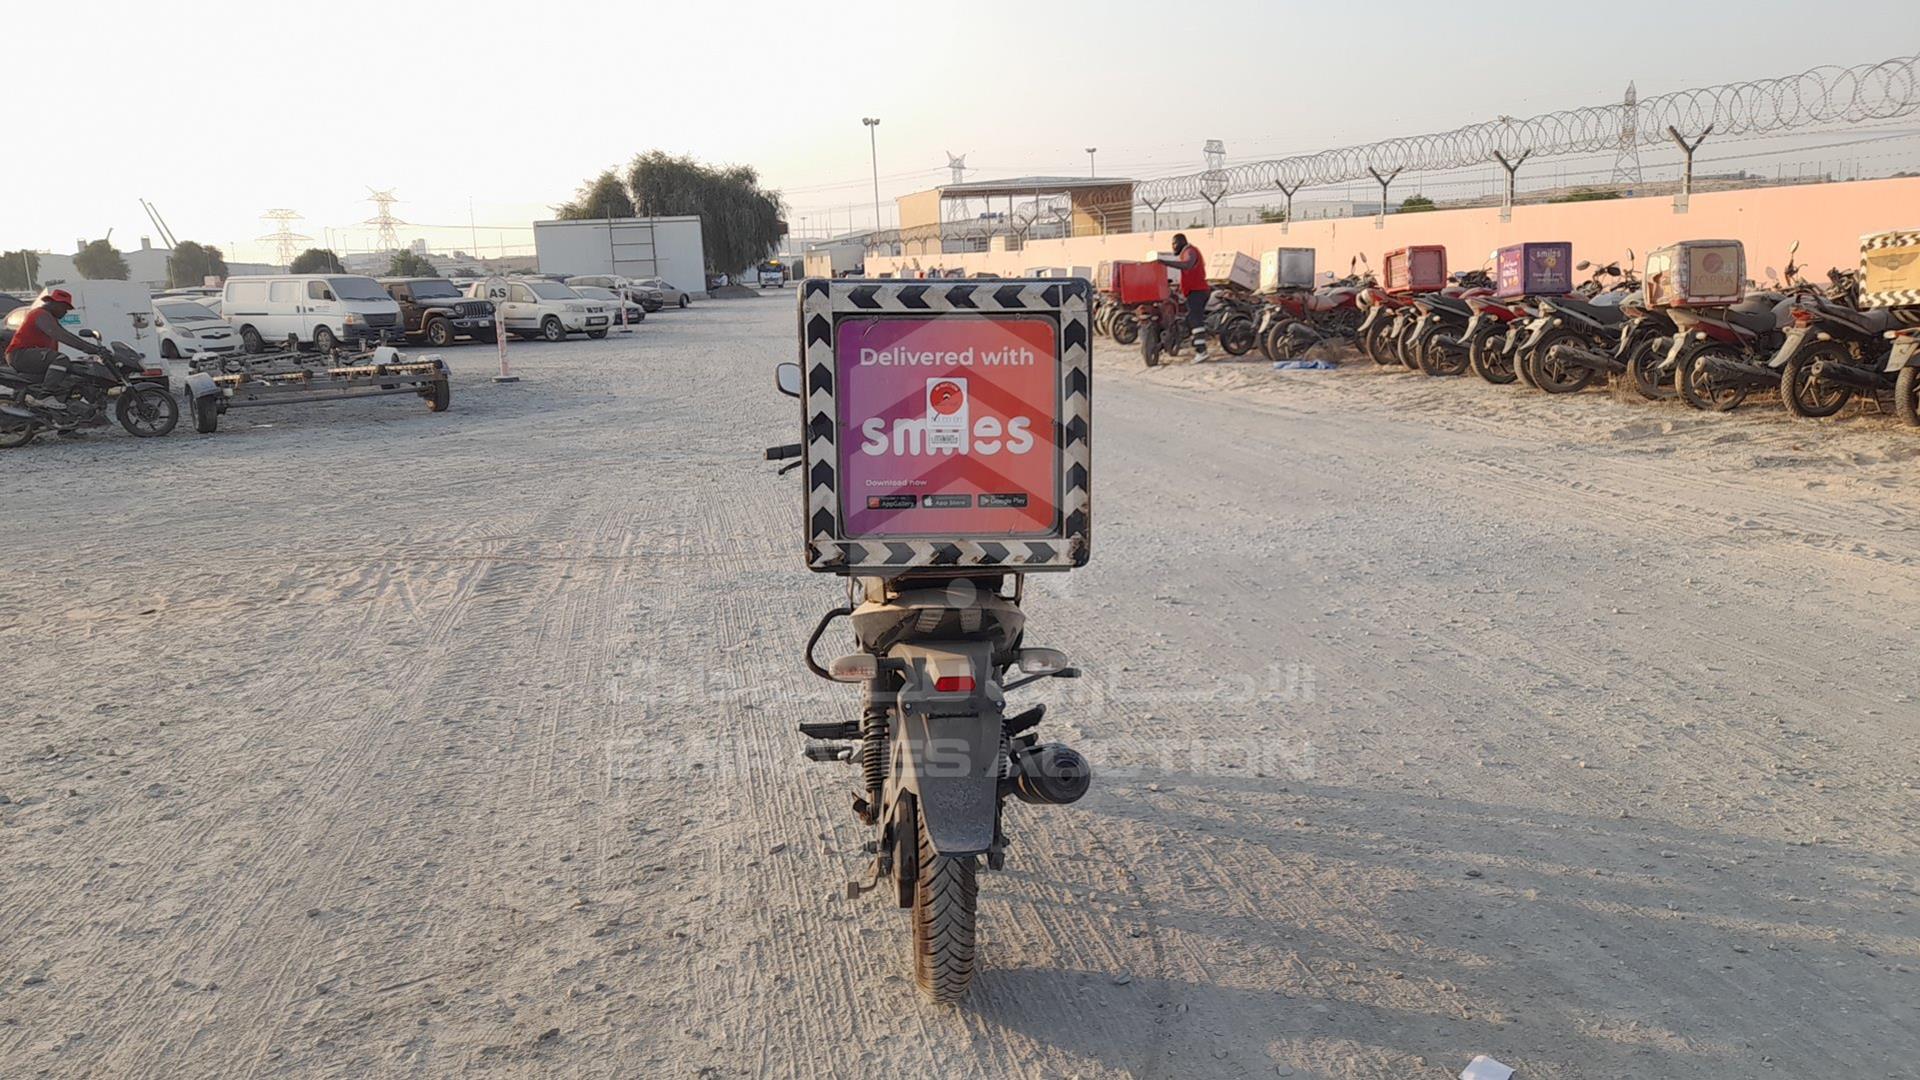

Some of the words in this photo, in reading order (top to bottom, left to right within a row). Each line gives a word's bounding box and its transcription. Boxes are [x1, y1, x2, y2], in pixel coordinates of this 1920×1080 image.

[489, 287, 507, 299] AS
[860, 346, 974, 366] Delivered
[981, 346, 1035, 366] with
[861, 413, 1034, 456] smles
[865, 479, 907, 487] Download
[990, 497, 1011, 505] Google
